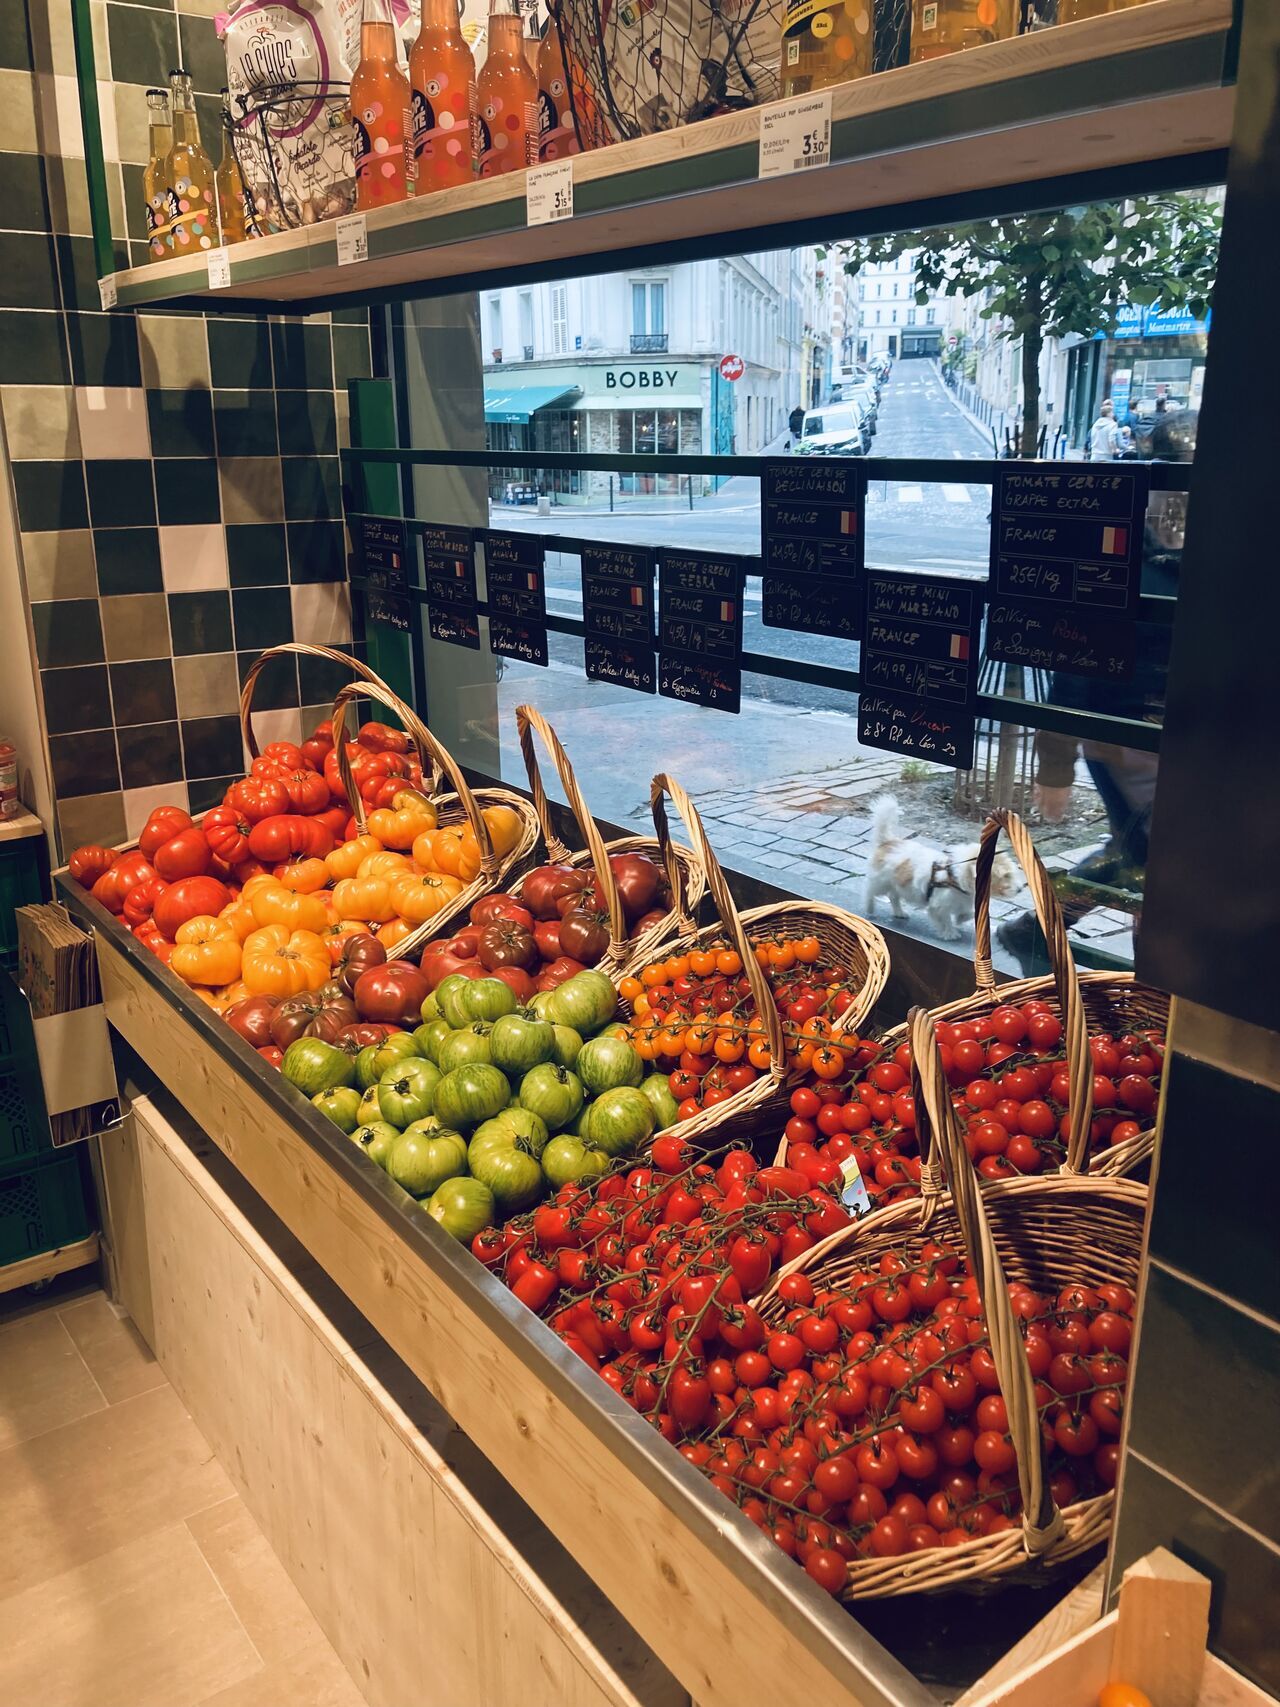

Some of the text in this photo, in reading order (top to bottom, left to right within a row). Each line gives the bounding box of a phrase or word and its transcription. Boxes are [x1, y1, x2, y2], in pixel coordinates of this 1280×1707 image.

[255, 40, 297, 87] CHIPS
[764, 112, 786, 122] BOUTEILLE
[803, 135, 811, 155] 3
[813, 141, 824, 153] 30
[554, 192, 560, 208] 3
[606, 371, 678, 388] BOBBY
[769, 466, 804, 477] TOMATE
[1006, 476, 1122, 490] TOMATE CERISE
[1006, 494, 1100, 510] GRAPPE EXTRA
[776, 511, 818, 524] FRANCE
[1004, 528, 1056, 542] FRANCE
[489, 538, 512, 548] TOMATE
[666, 560, 731, 578] TOMATE GREEN
[490, 573, 512, 581] FRANCE
[680, 574, 716, 590] ZEBRA
[590, 586, 621, 597] FRANCE
[874, 582, 950, 601] TOMATE MINI
[670, 598, 704, 612] FRANCE
[874, 597, 894, 610] SAN
[871, 627, 920, 646] FRANCE
[1108, 658, 1125, 673] 37
[709, 689, 717, 699] 13
[861, 698, 892, 715] Cultivé
[864, 723, 872, 736] à
[889, 725, 903, 743] Pol
[902, 735, 914, 745] de
[918, 734, 936, 750] Léon
